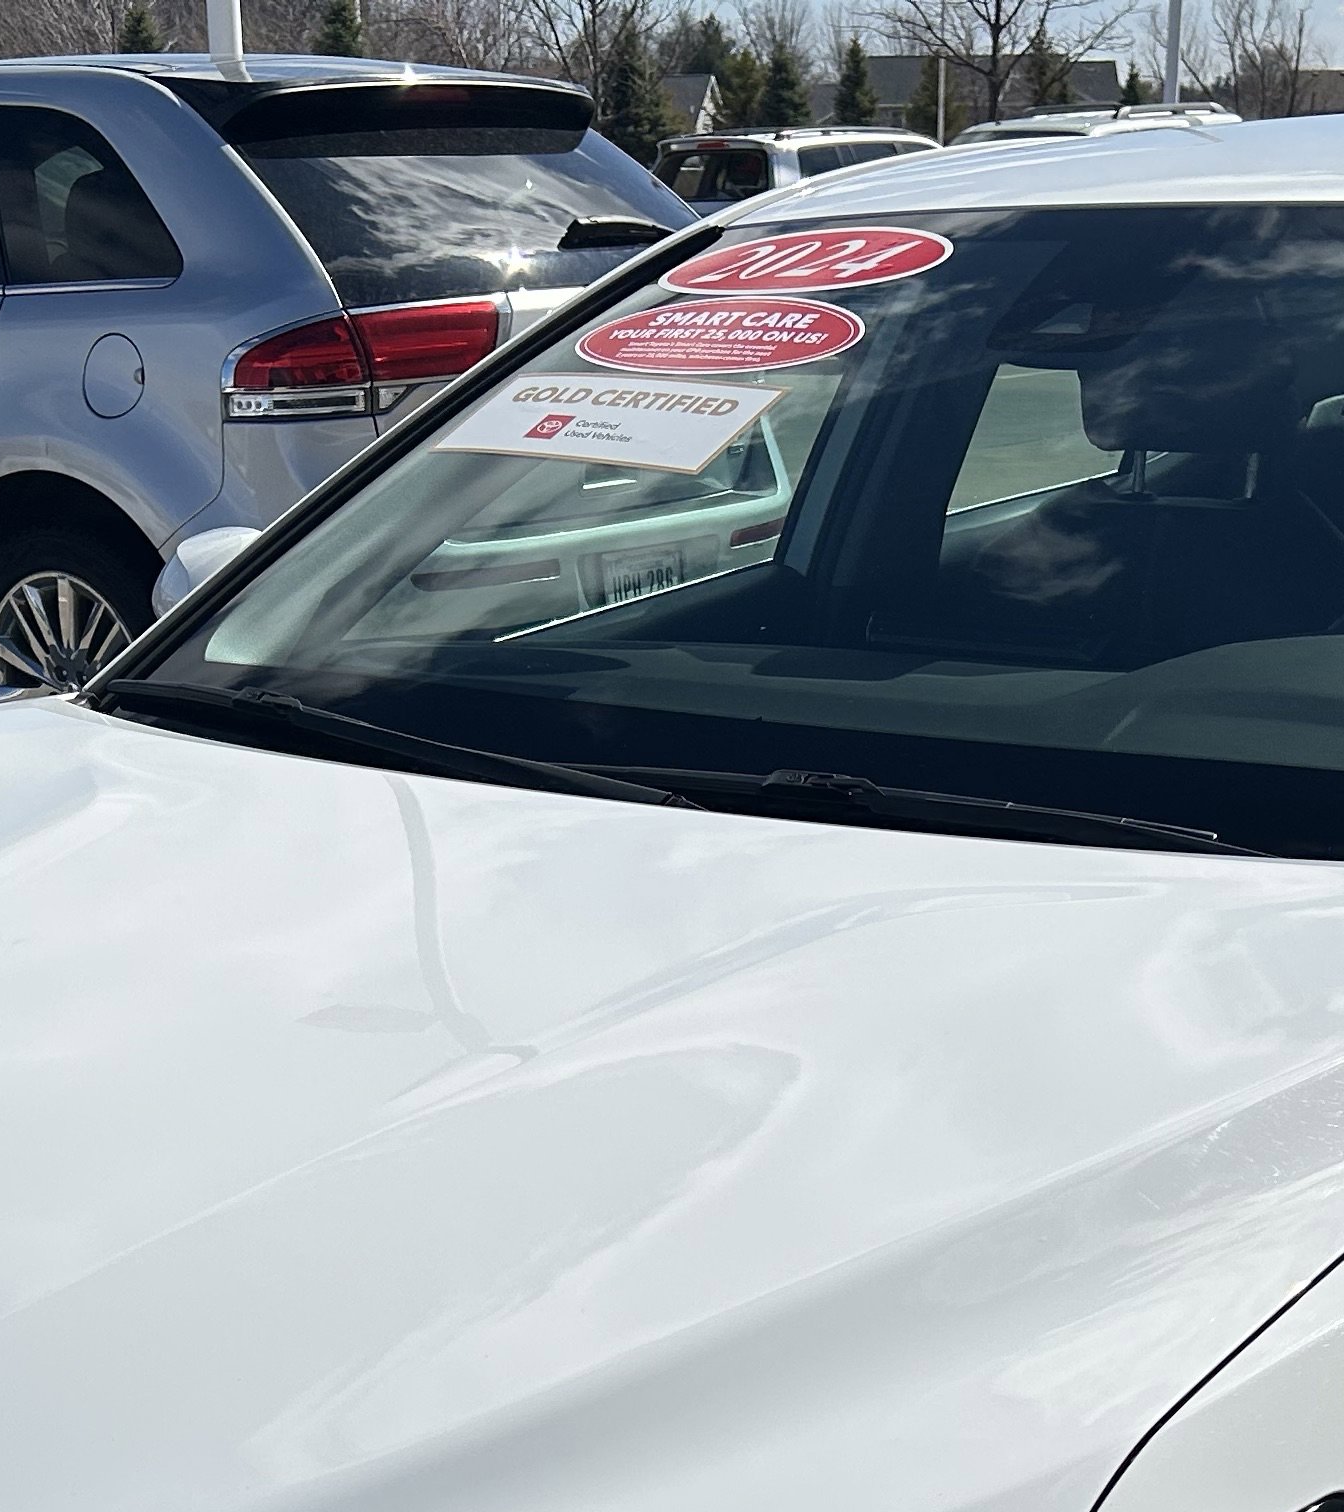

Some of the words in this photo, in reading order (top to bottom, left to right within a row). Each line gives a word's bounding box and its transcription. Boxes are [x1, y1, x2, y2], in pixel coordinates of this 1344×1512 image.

[687, 239, 923, 285] 2024
[648, 311, 737, 327] SMART
[742, 311, 821, 329] CARE
[609, 328, 657, 340] YOUR
[654, 328, 706, 339] FIRST
[700, 328, 764, 341] 25,000
[762, 330, 796, 342] ON
[793, 331, 829, 345] US!
[512, 386, 593, 404] GOLD
[591, 389, 740, 417] CERTIFIED
